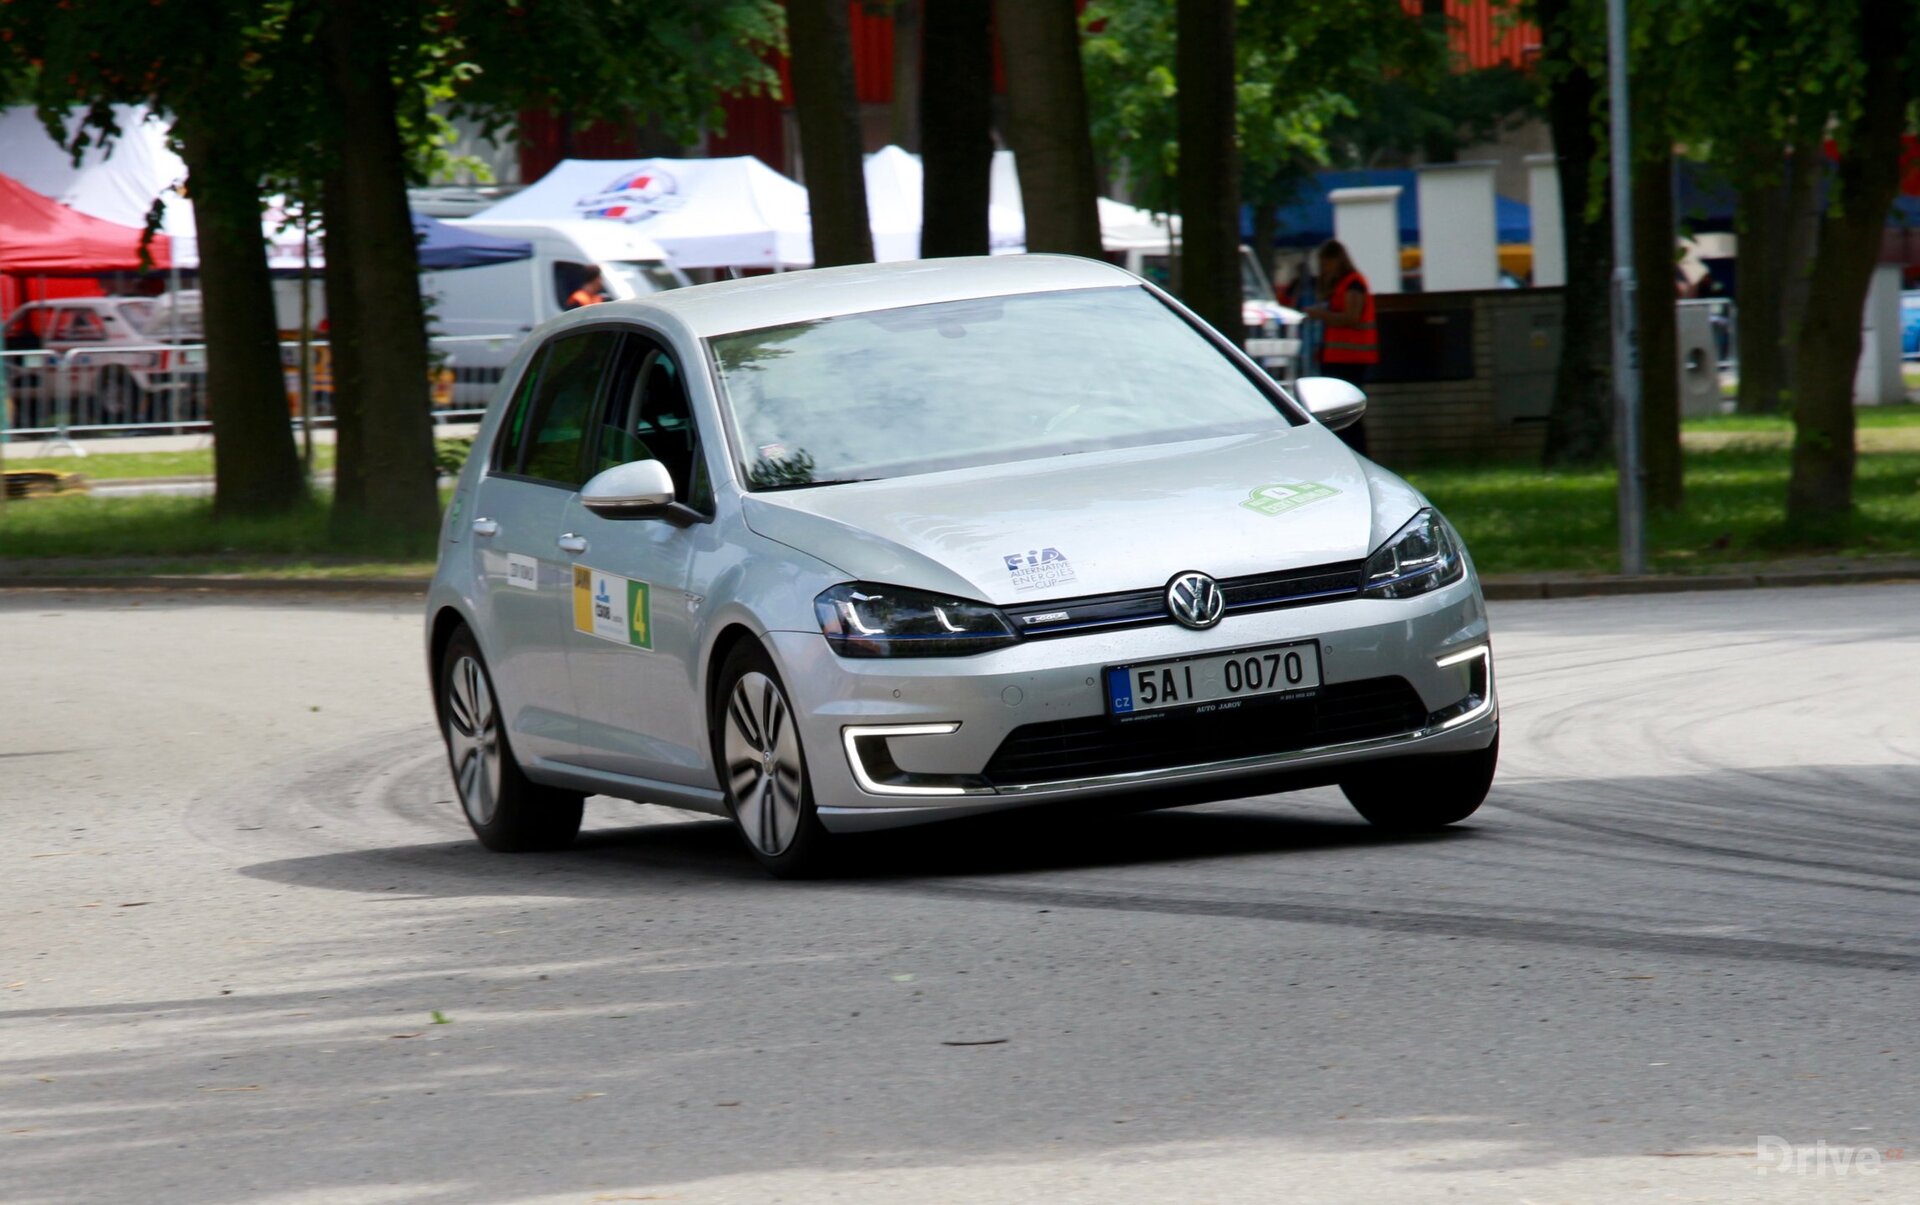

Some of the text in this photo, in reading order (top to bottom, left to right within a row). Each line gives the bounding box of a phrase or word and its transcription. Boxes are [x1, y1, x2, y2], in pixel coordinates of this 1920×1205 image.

[1010, 560, 1071, 578] ALTERNATIVE
[1012, 569, 1075, 586] ENERGIES
[1035, 578, 1058, 589] CUP
[632, 587, 647, 643] 4
[1138, 651, 1303, 704] 5AI 0070
[1114, 696, 1131, 708] CZ
[1196, 704, 1216, 713] AUTO
